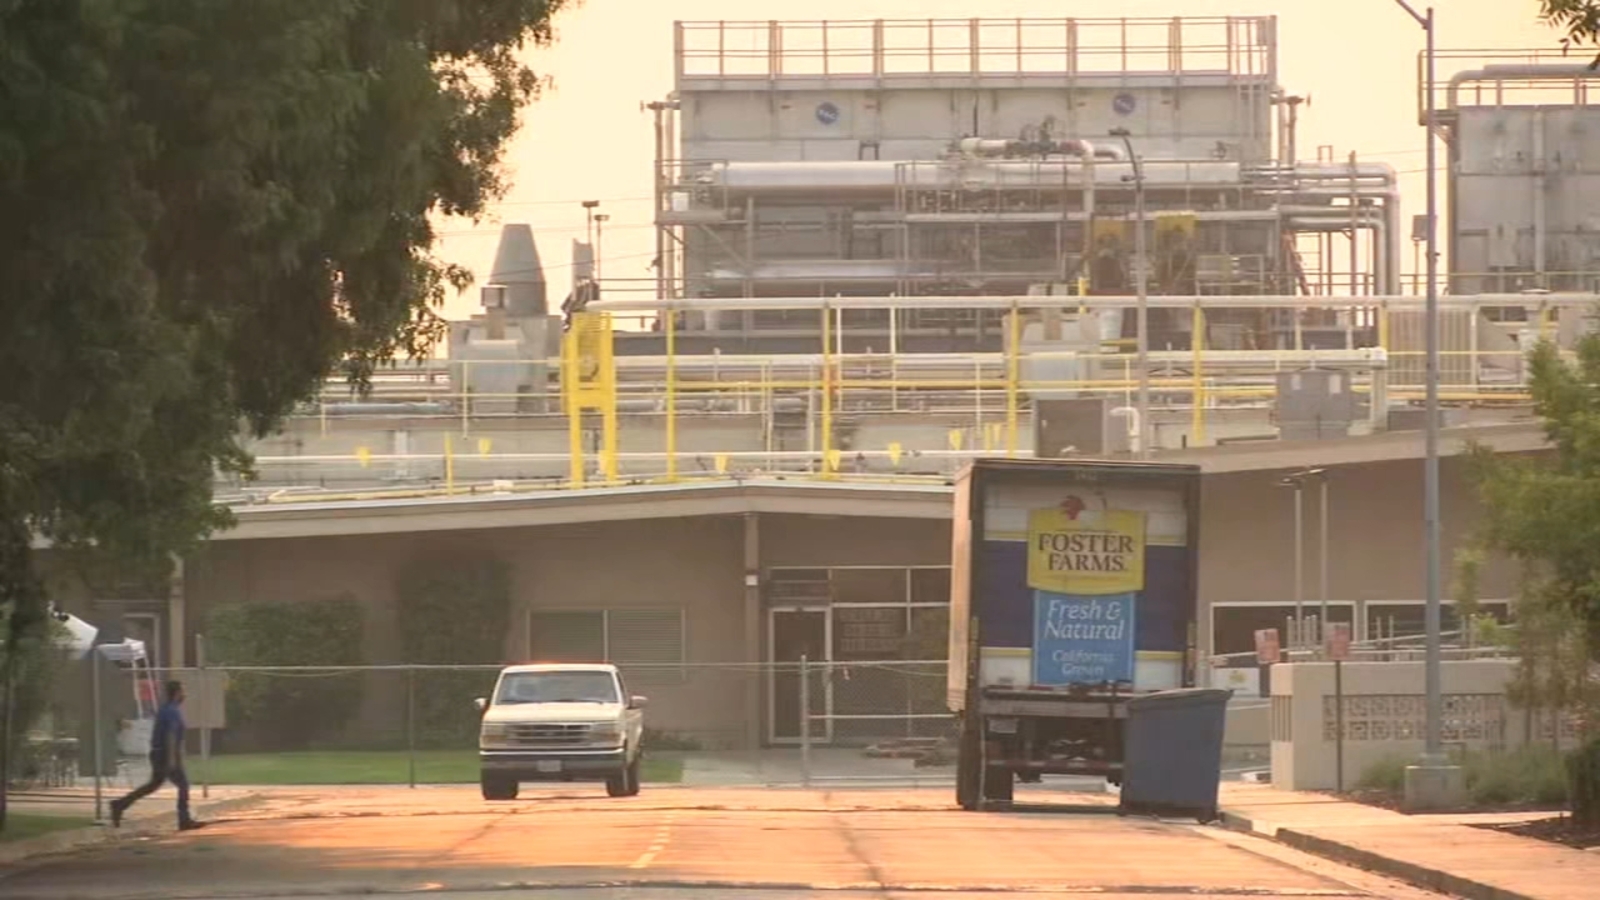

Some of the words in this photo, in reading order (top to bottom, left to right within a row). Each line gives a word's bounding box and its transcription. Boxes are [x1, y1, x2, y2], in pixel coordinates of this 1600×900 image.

[1039, 533, 1134, 553] FOSTER
[1048, 553, 1125, 571] FARMS
[1047, 599, 1101, 620] Fresh
[1106, 601, 1121, 620] &
[1044, 620, 1125, 640] Natural
